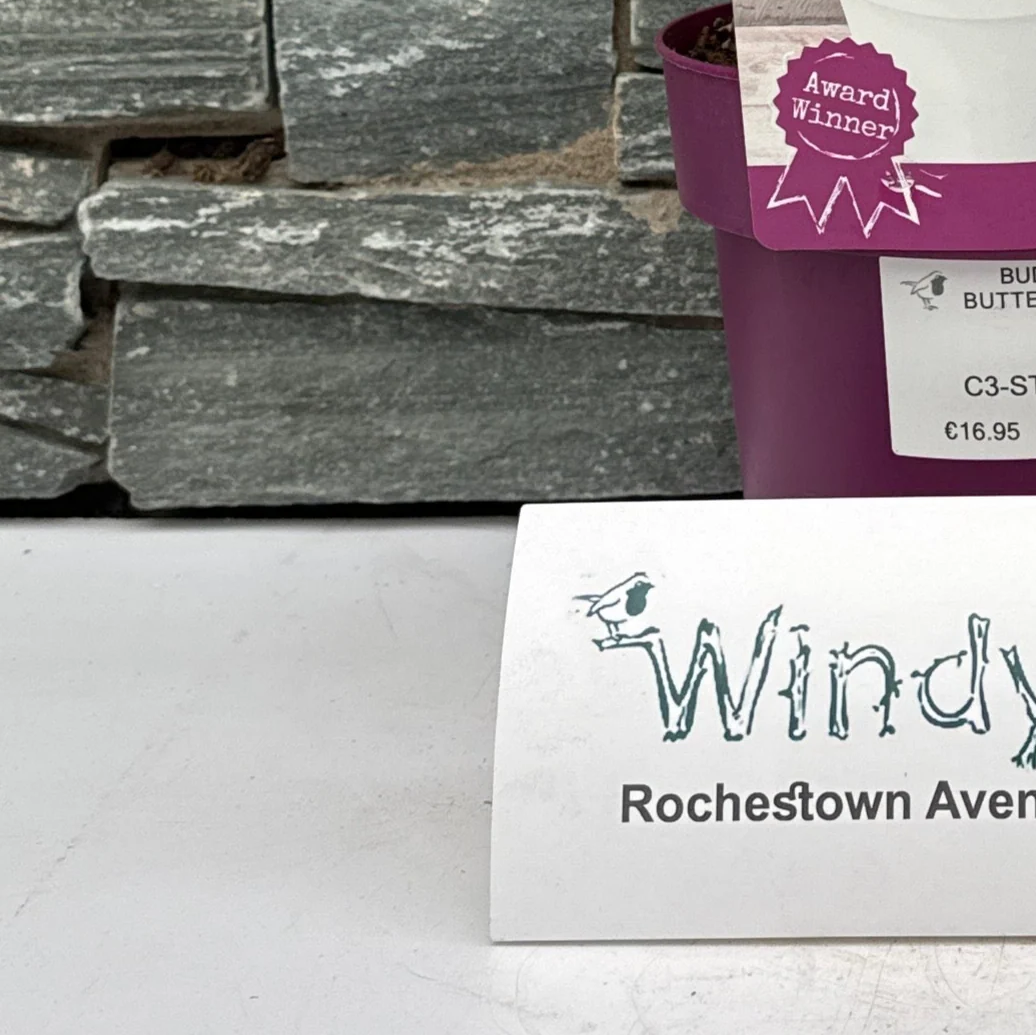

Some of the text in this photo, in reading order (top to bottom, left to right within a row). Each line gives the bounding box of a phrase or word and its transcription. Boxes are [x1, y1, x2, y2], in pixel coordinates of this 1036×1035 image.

[802, 71, 891, 111] Award
[791, 97, 895, 140] Winner
[944, 421, 1021, 441] €16.95
[621, 780, 911, 823] Rochestown
